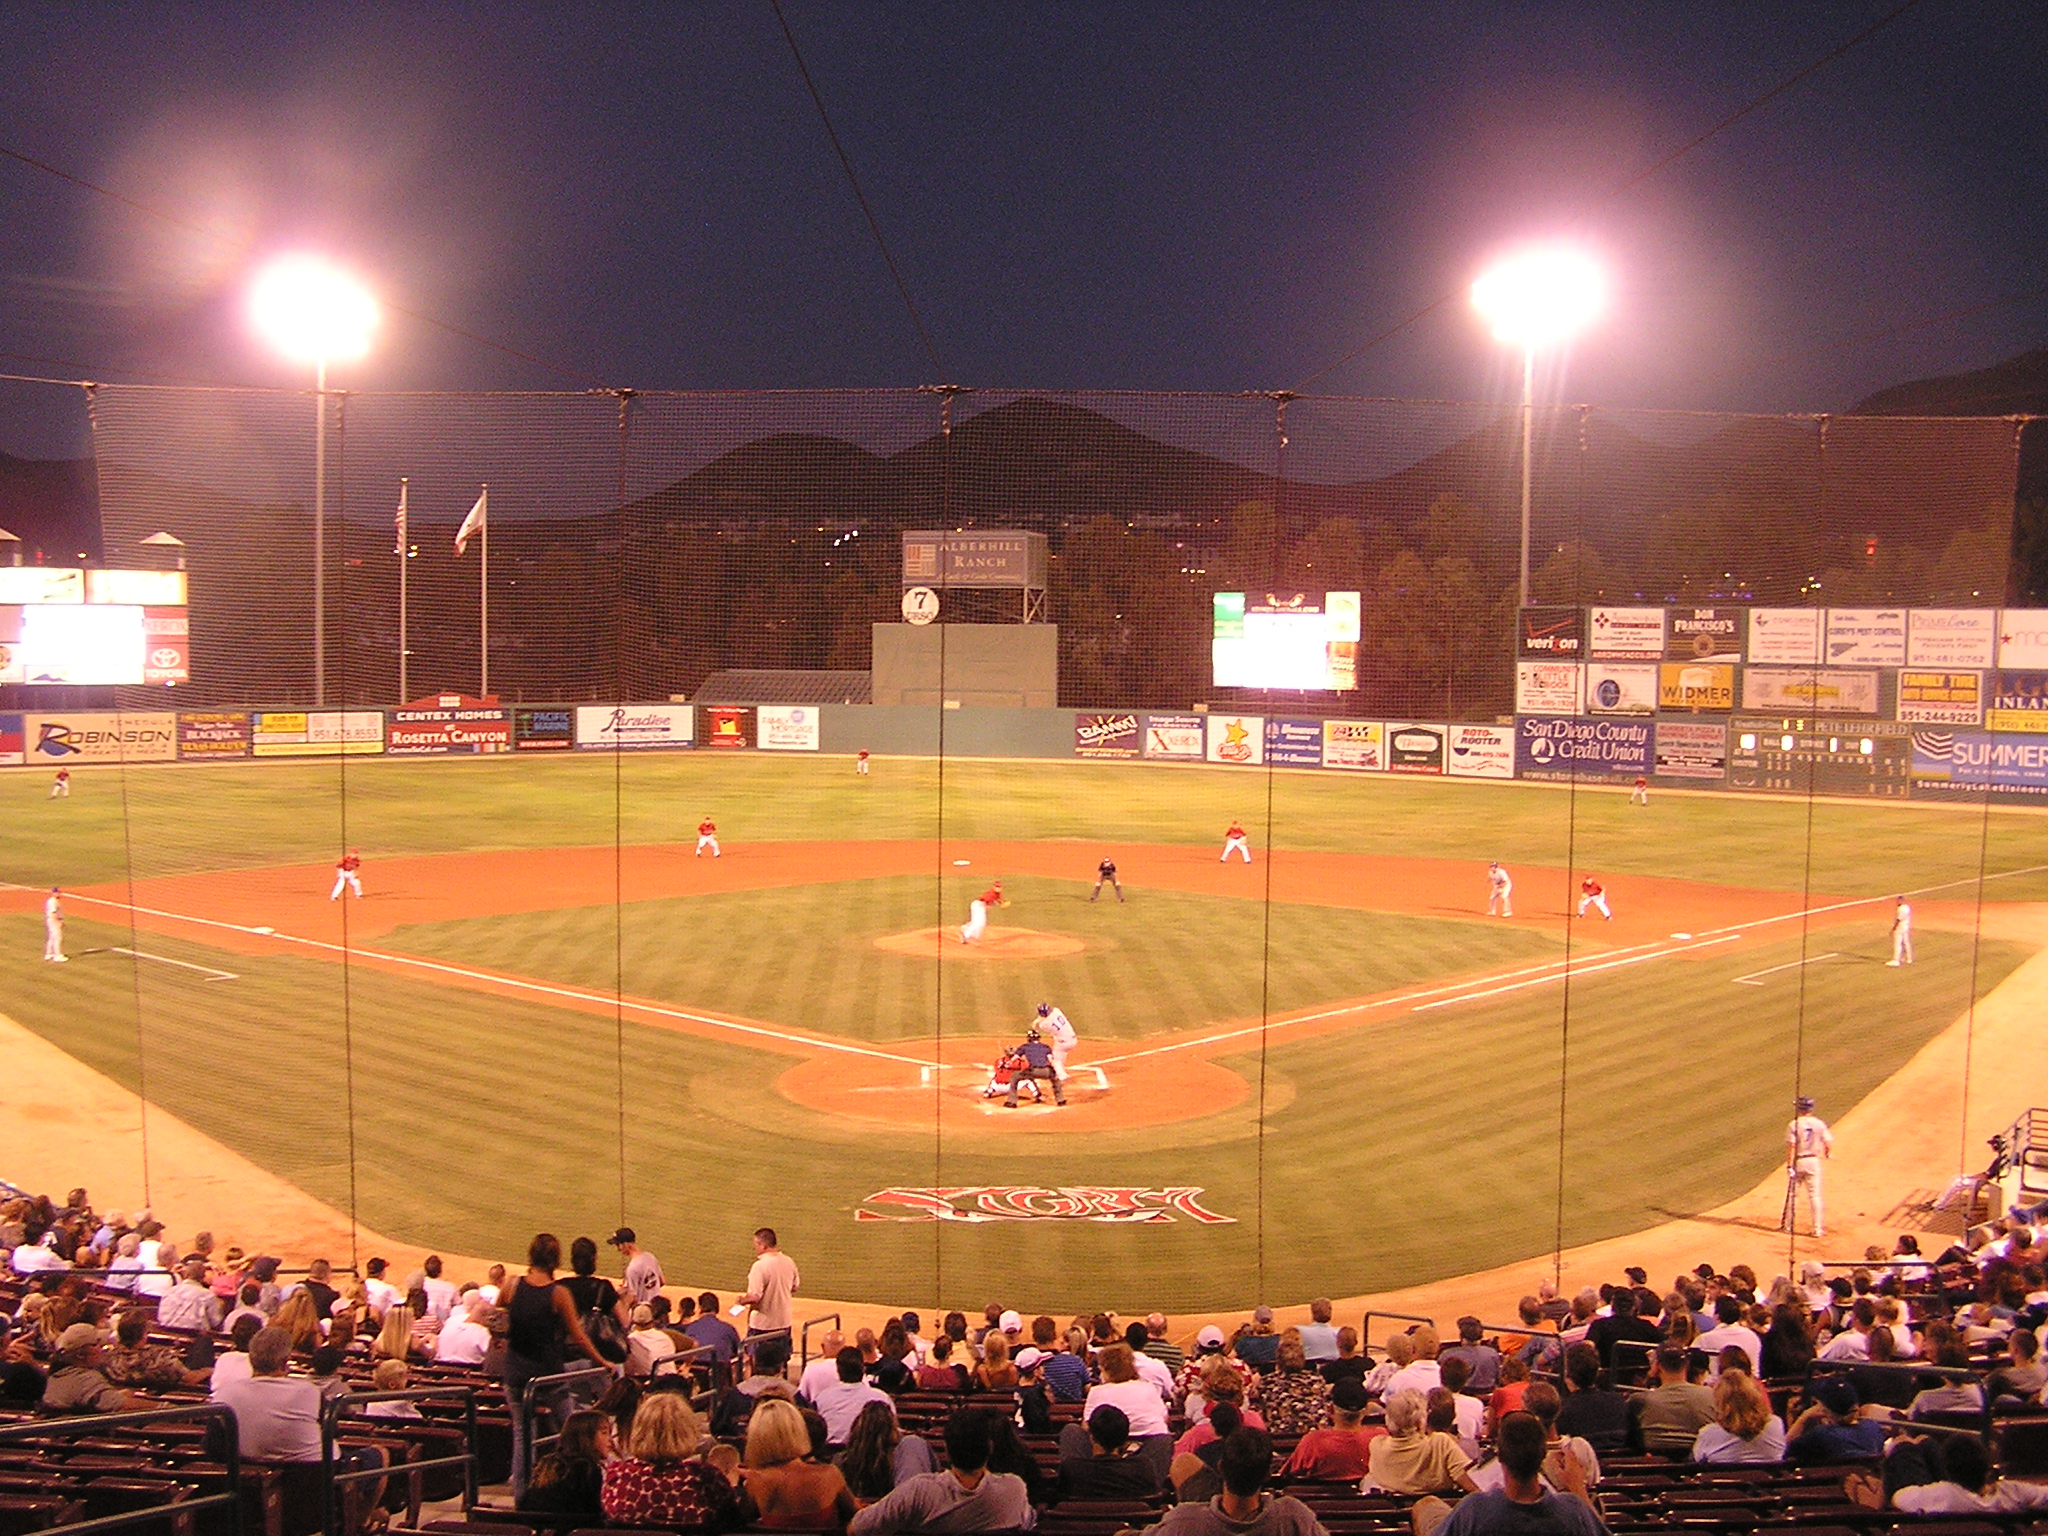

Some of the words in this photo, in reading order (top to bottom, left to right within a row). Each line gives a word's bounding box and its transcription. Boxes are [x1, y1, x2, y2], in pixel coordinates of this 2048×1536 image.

[940, 542, 1022, 551] ALBERHILL
[955, 556, 1006, 567] RANCH
[914, 591, 928, 610] 7
[1674, 620, 1734, 632] FRANCISCO'S
[1527, 636, 1578, 653] verizon
[1662, 687, 1730, 699] WIDMER
[396, 711, 452, 721] CENTEX
[455, 710, 503, 720] HOMES
[600, 708, 671, 732] Paradise
[35, 723, 172, 754] ROBINSON
[392, 731, 449, 744] ROSETTA
[451, 730, 506, 743] CANYON
[1462, 728, 1493, 737] ROTO-
[1523, 719, 1552, 737] San
[1552, 719, 1595, 742] Diego
[1596, 721, 1647, 745] County
[1460, 737, 1502, 745] ROOTER
[1559, 740, 1600, 759] Credit
[1602, 741, 1645, 761] Union
